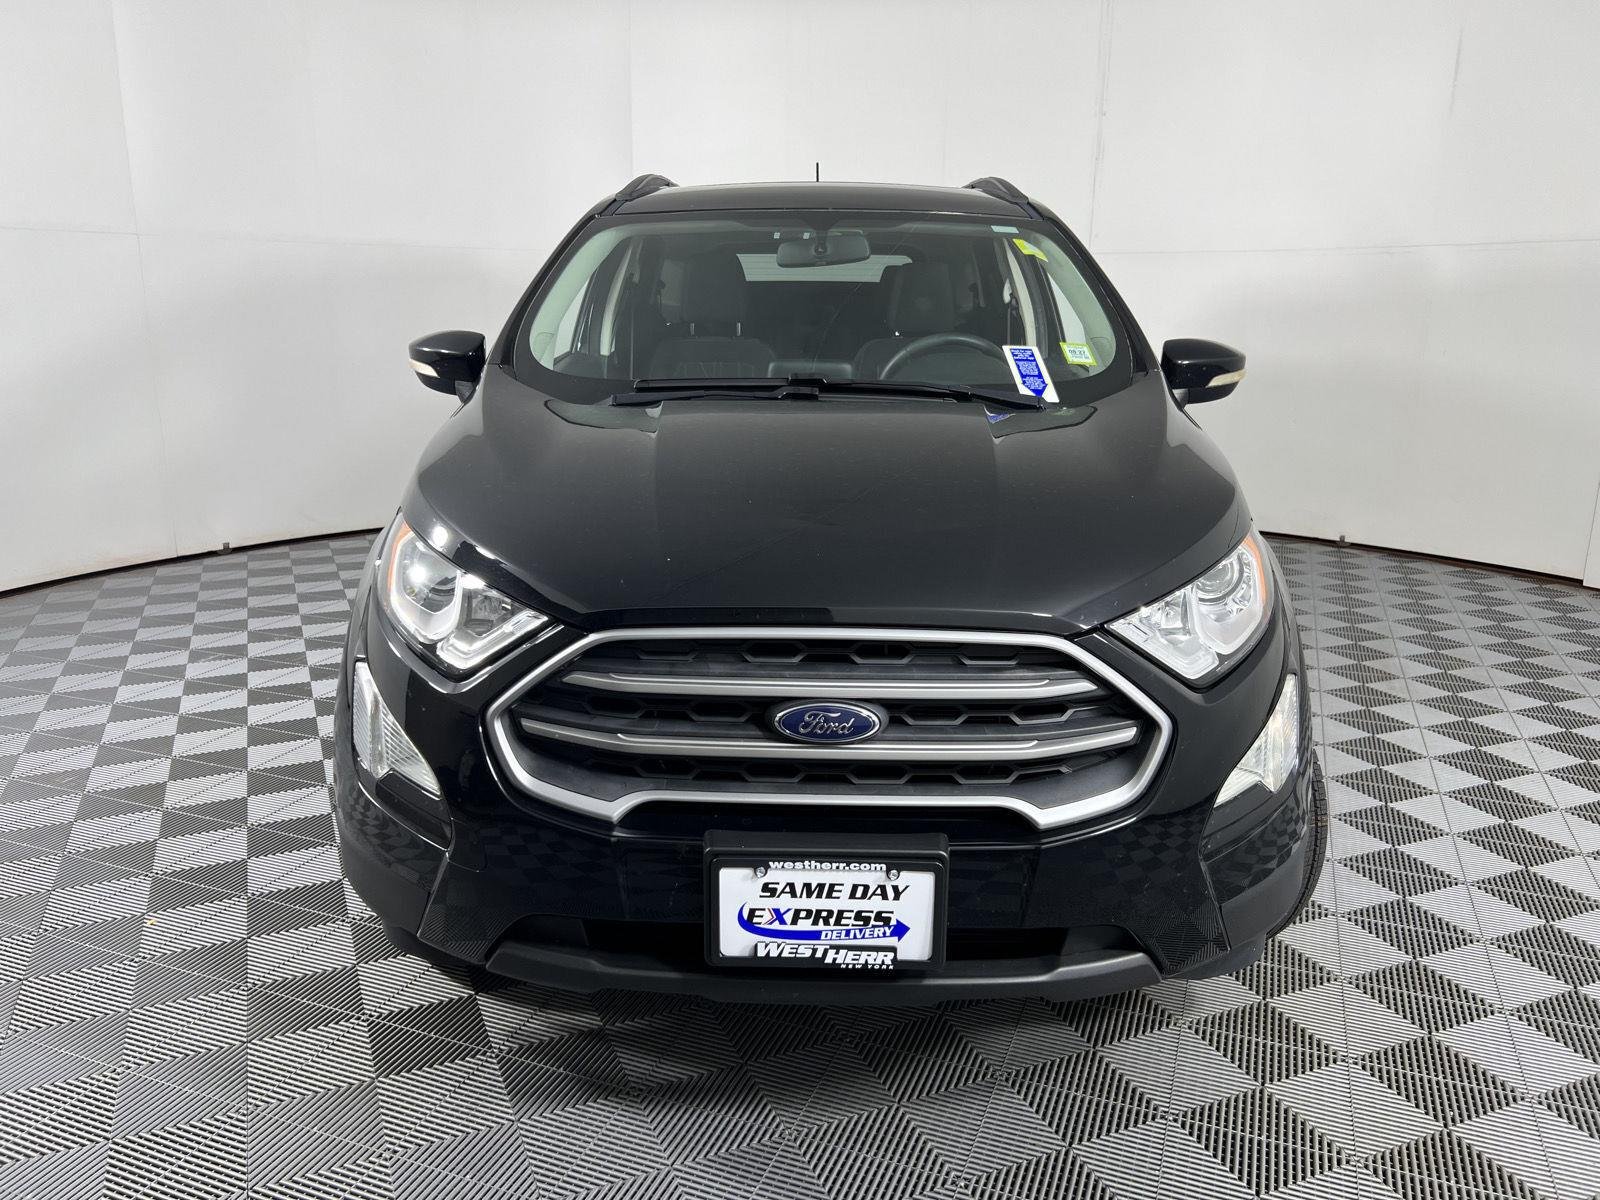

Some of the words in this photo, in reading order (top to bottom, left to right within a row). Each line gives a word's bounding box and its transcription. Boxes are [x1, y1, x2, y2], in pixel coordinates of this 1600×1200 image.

[798, 710, 855, 734] Ford
[768, 860, 887, 871] westherr.com
[759, 882, 844, 899] SAME
[848, 884, 910, 901] DAY
[747, 907, 894, 926] EXPRESS
[820, 926, 894, 940] DELIVERY
[755, 941, 830, 958] WEST
[824, 949, 895, 965] HERR
